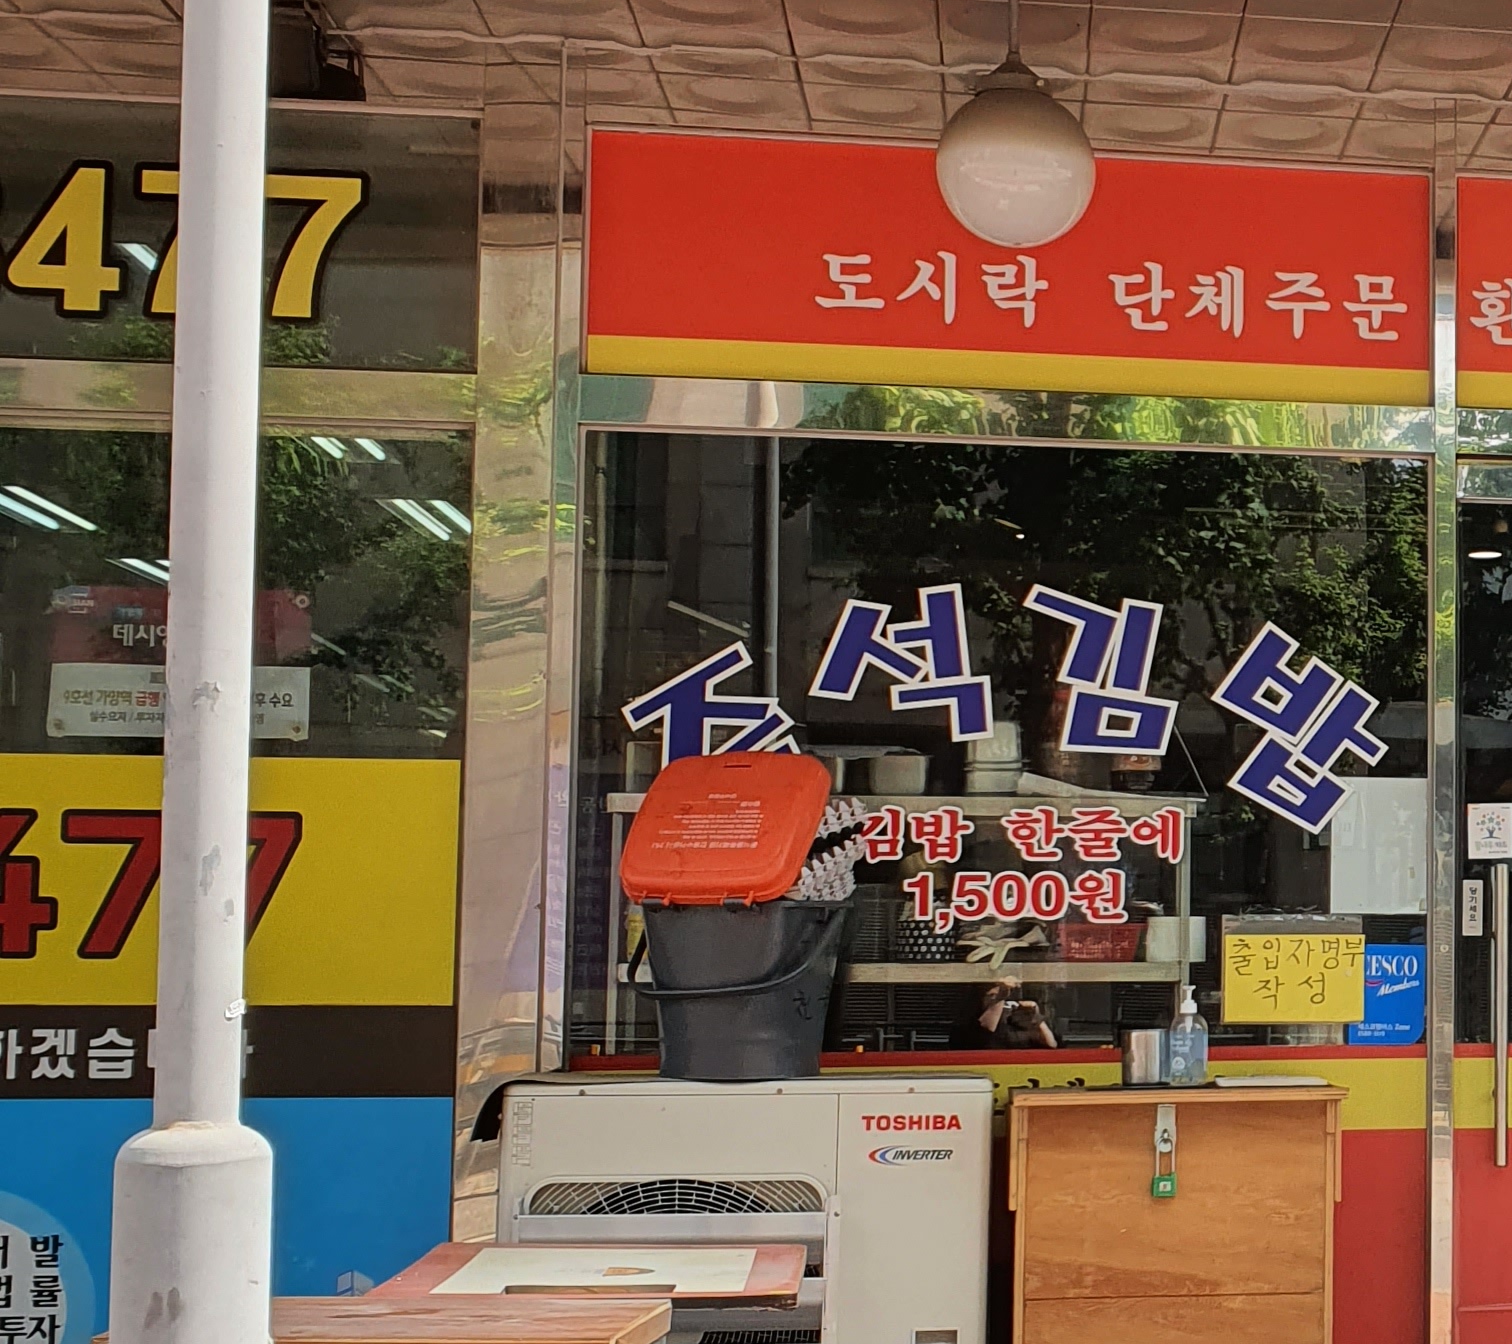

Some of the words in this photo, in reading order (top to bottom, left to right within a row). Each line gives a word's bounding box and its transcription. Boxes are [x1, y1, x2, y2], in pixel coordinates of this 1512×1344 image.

[814, 250, 1050, 329] 도시락
[1108, 261, 1408, 342] 단체주문
[859, 805, 975, 864] 김밥
[1002, 805, 1185, 865] 한줄에
[903, 867, 1130, 935] 1,500원
[1228, 937, 1366, 977] 출입자명부
[861, 1114, 962, 1131] TOSHIBA
[892, 1149, 954, 1161] INVERTER
